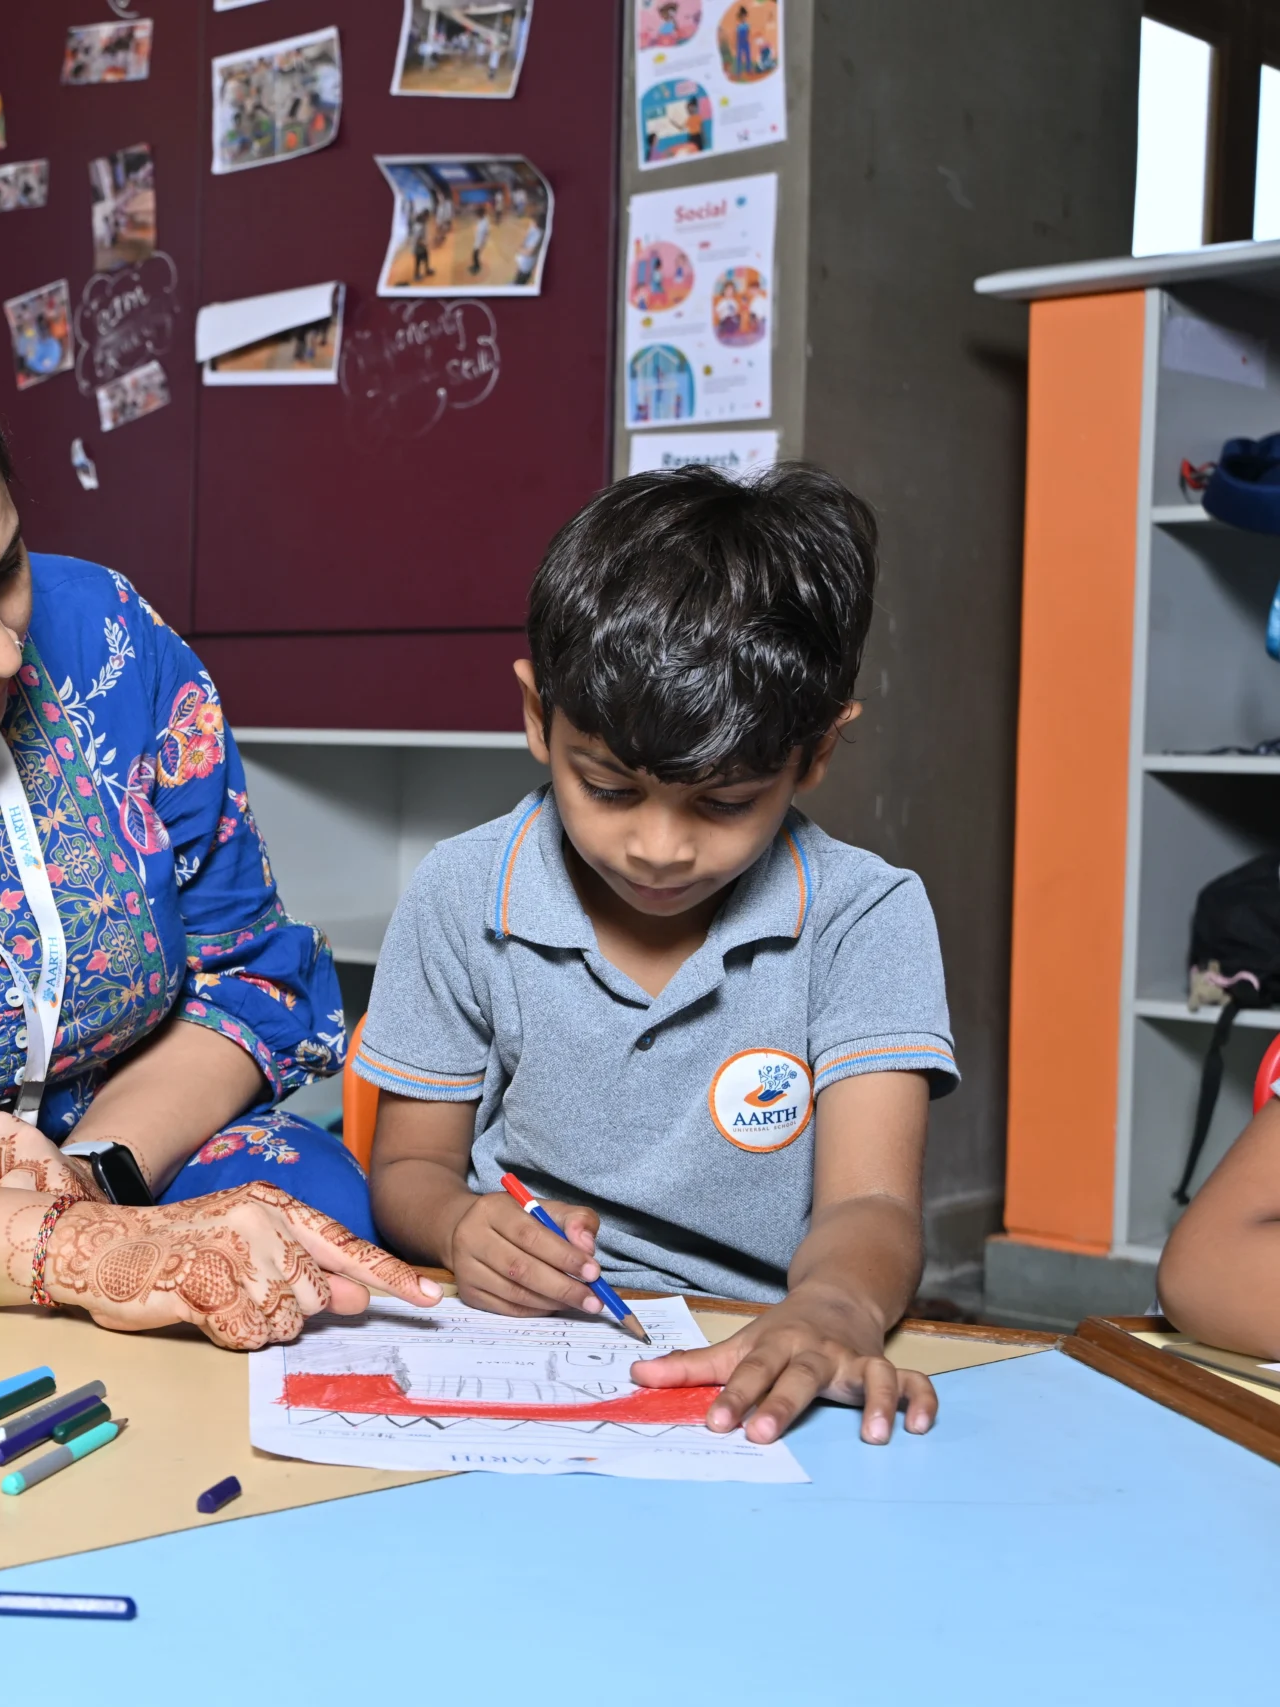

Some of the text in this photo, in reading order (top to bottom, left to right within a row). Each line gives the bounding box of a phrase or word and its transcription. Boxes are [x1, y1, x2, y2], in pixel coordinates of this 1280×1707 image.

[674, 199, 728, 224] Social
[9, 805, 31, 852] AARTH
[46, 937, 59, 988] AARTH
[732, 1106, 798, 1126] AARTH
[773, 1120, 797, 1130] SCHOOL
[451, 1454, 551, 1466] AARTH
